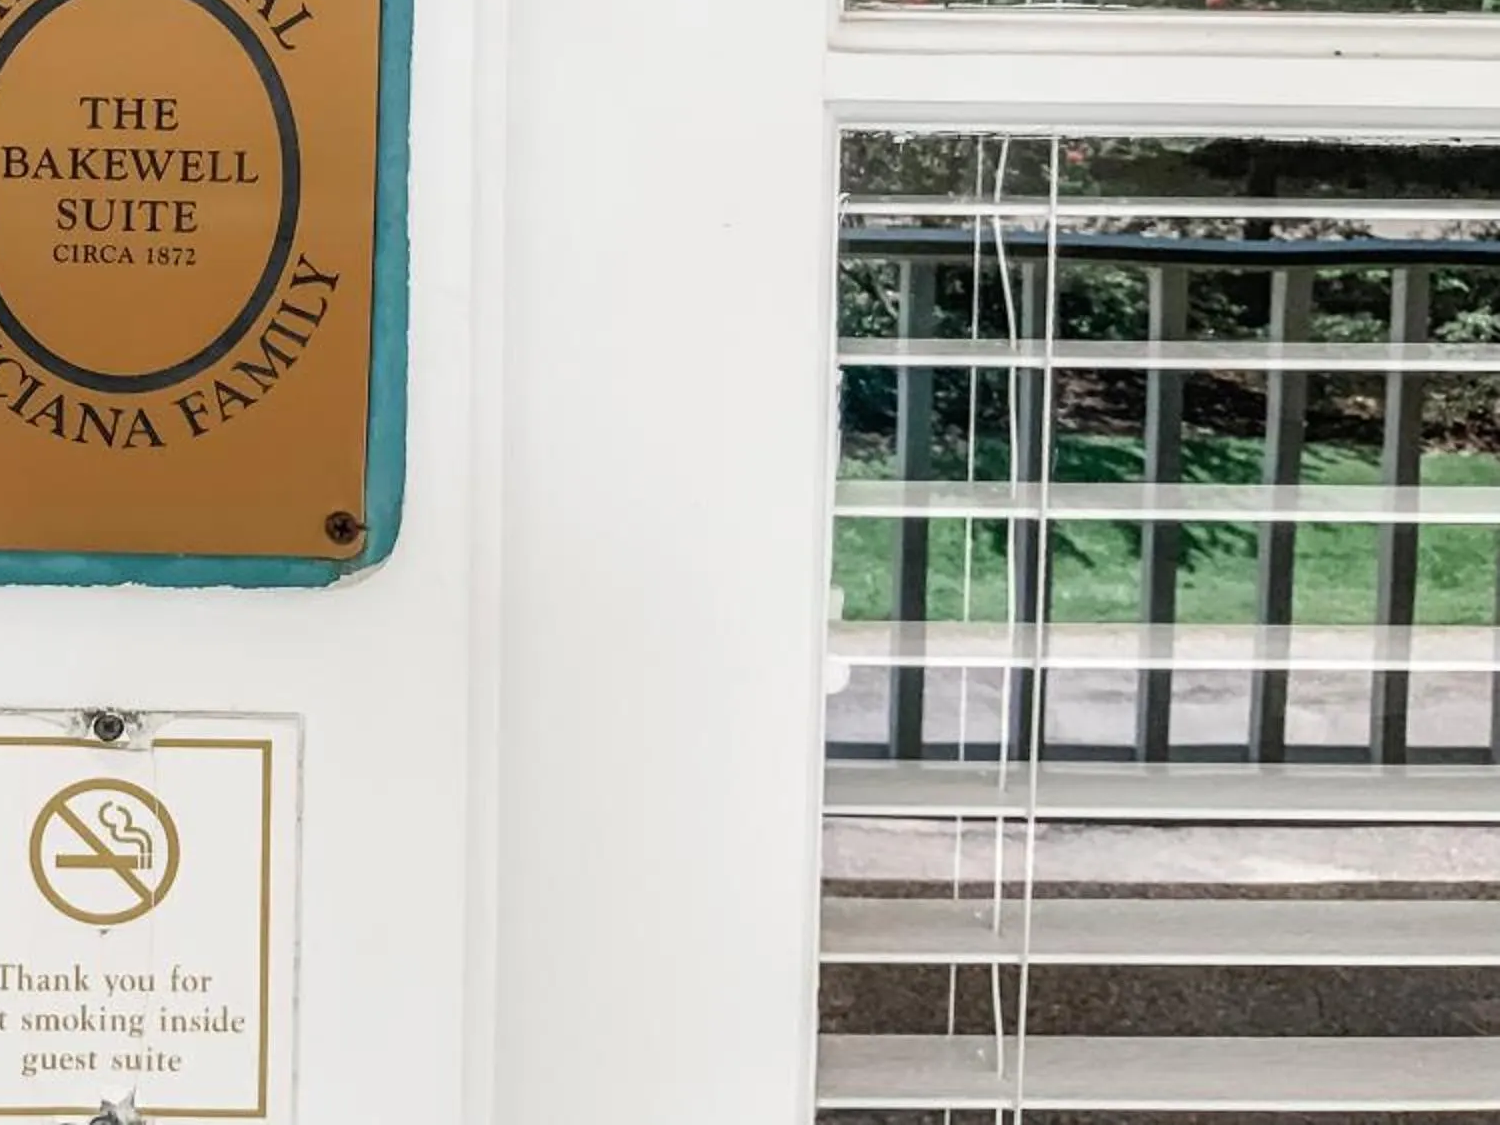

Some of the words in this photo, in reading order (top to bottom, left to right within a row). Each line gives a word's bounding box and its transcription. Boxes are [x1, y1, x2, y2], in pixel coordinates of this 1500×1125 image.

[79, 96, 180, 132] THE
[1, 145, 260, 186] BAKEWELL
[55, 198, 199, 234] SUITE
[52, 243, 136, 266] CIRCA
[145, 245, 198, 267] 1872
[171, 251, 340, 439] FAMILY
[104, 972, 156, 998] you
[169, 963, 213, 994] for
[20, 1004, 145, 1038] smoking
[159, 1007, 247, 1035] inside
[21, 1049, 99, 1077] guest
[110, 1046, 183, 1073] suite
